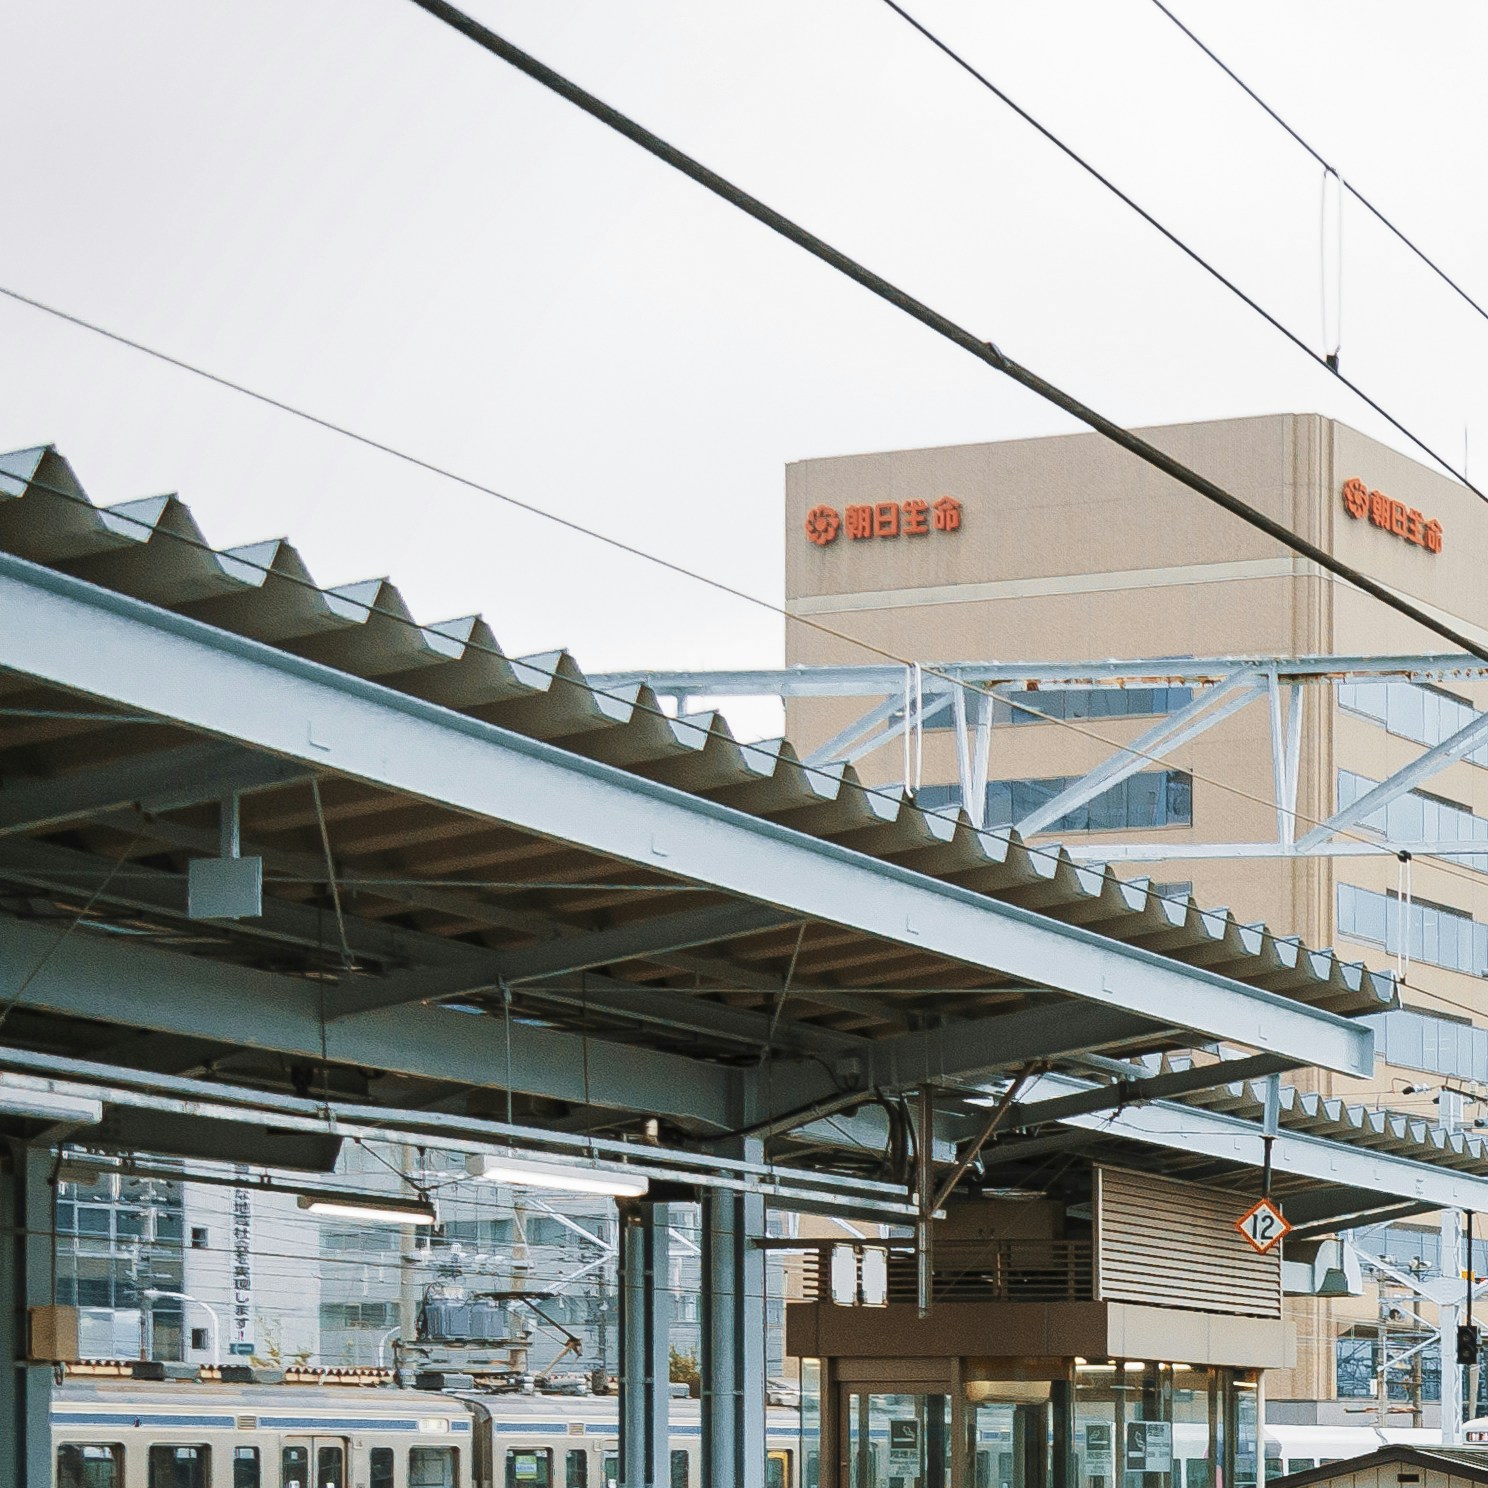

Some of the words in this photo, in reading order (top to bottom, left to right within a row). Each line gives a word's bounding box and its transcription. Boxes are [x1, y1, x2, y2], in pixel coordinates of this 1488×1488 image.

[844, 495, 962, 539] 朝日生命
[1369, 489, 1444, 555] 朝日生命
[1252, 1213, 1275, 1240] 12
